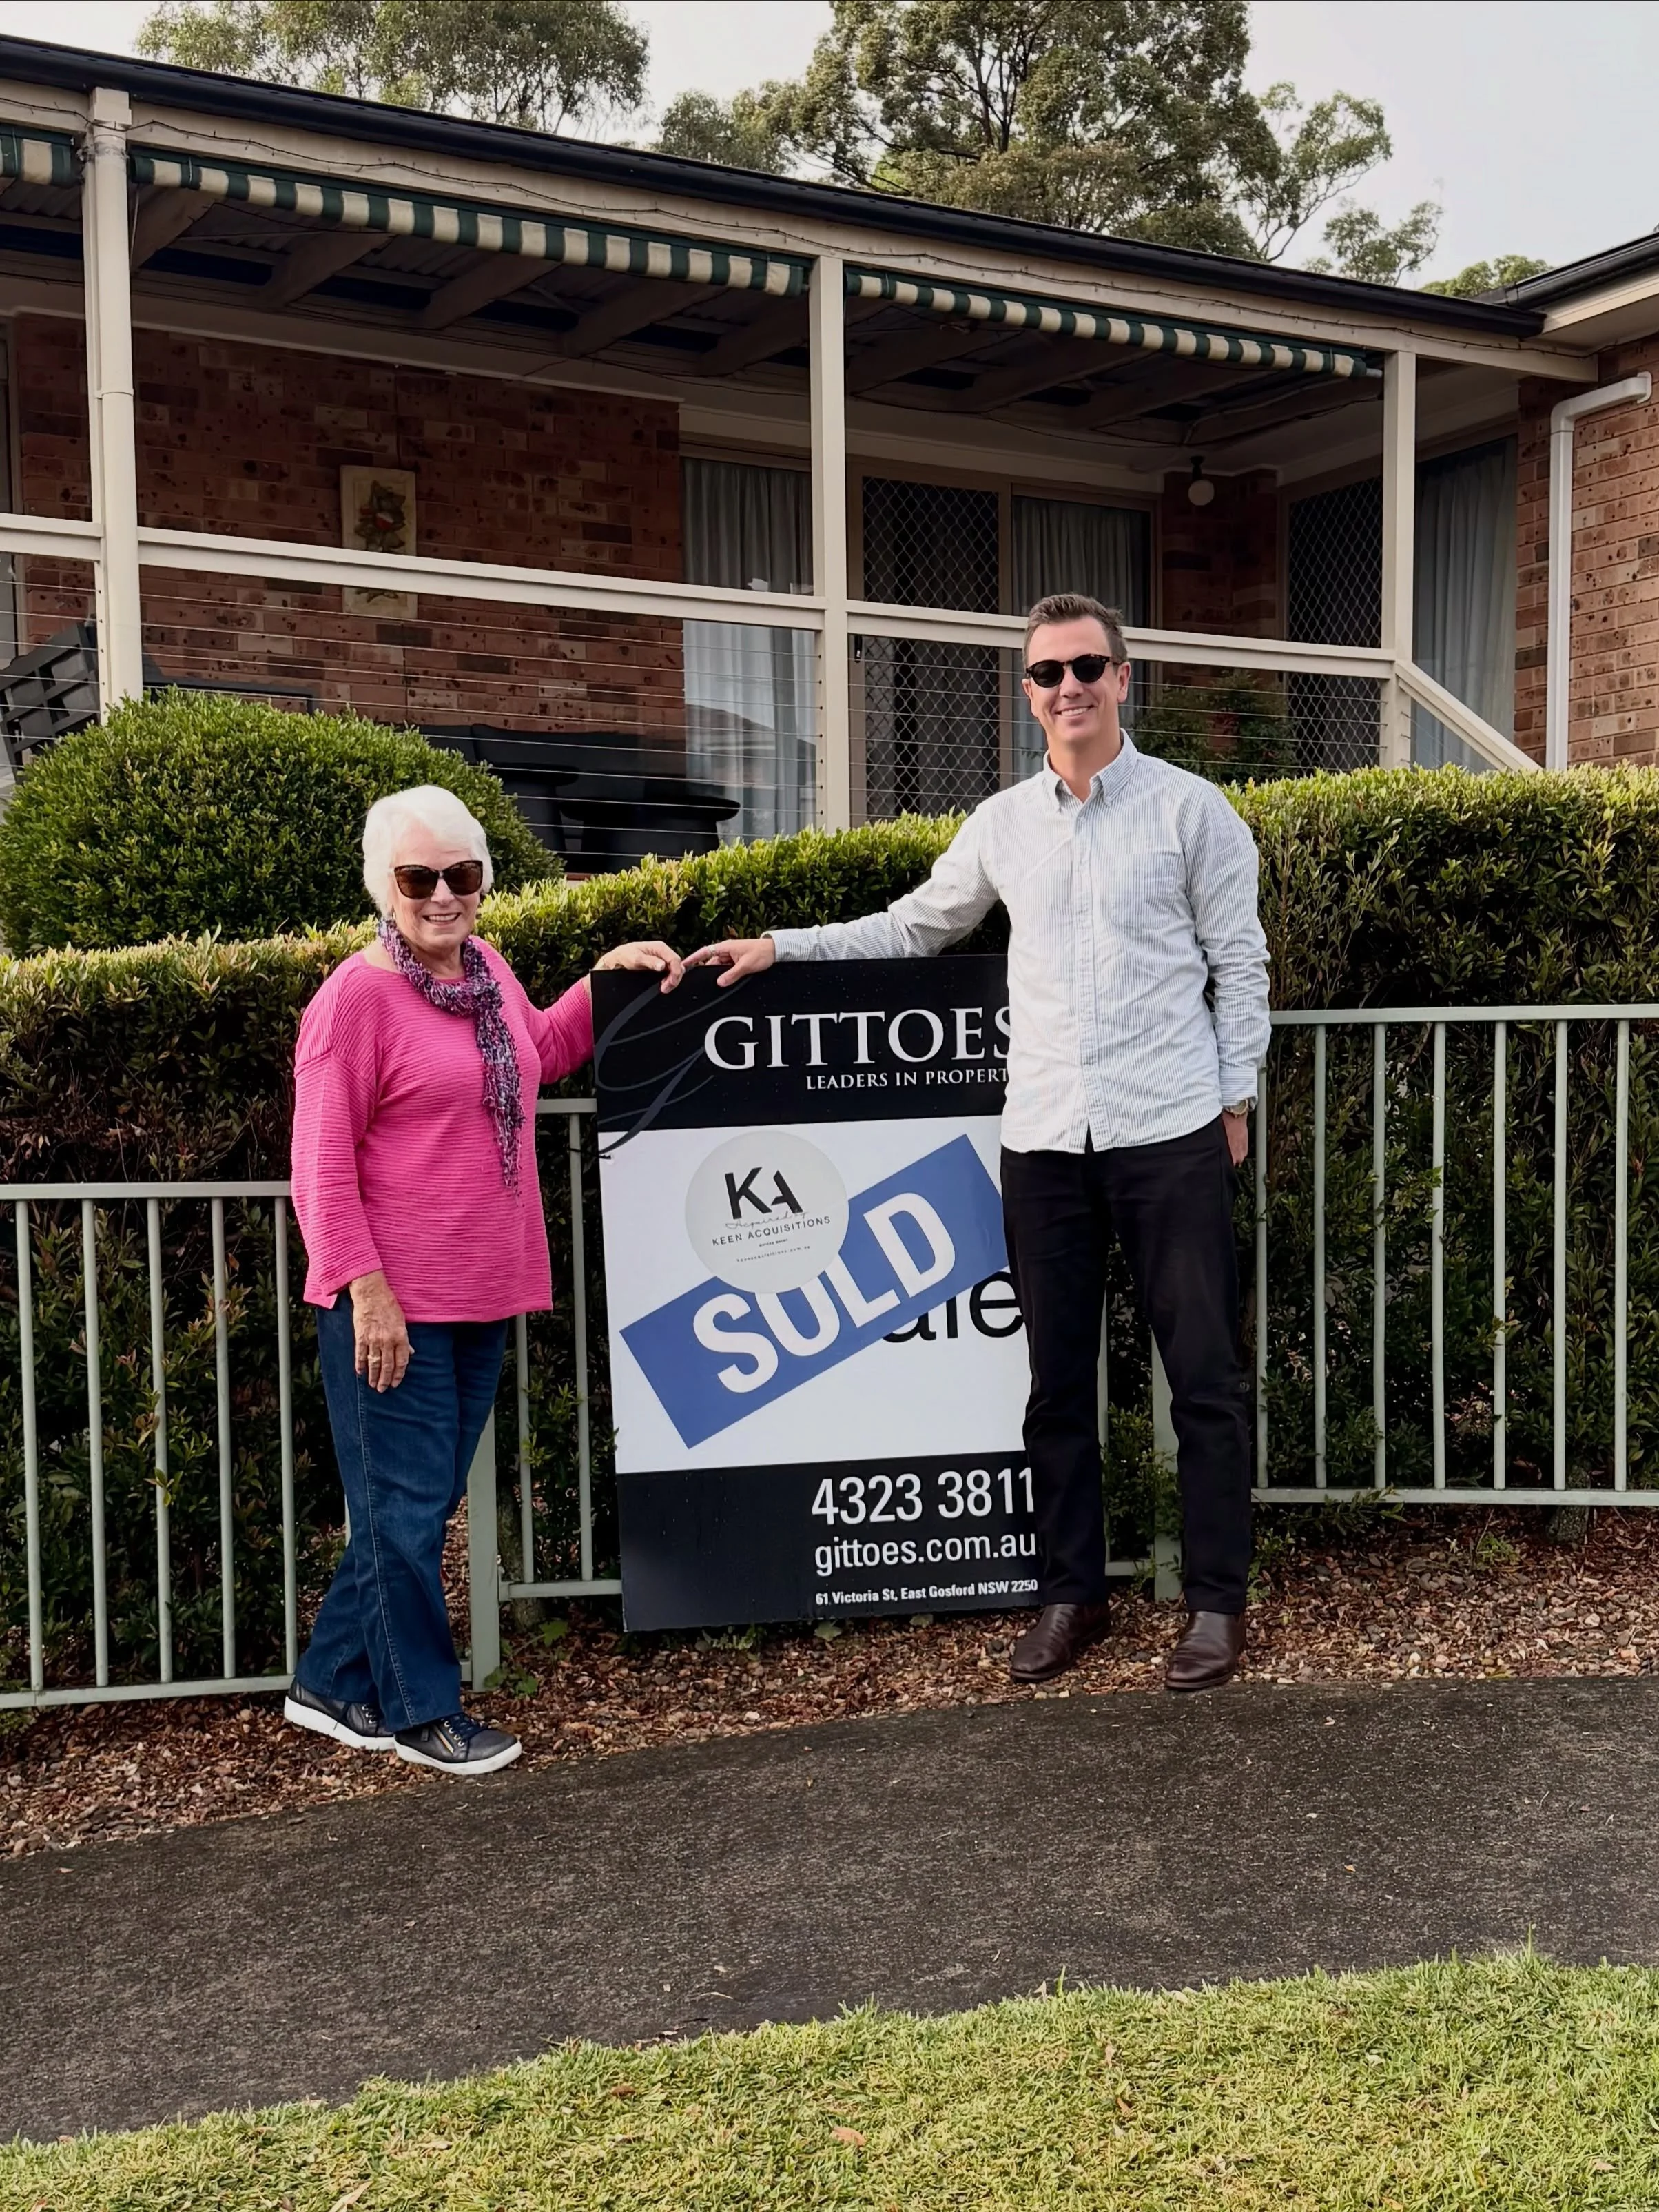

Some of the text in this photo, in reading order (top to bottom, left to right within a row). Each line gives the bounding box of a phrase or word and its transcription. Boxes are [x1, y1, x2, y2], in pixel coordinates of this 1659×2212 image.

[704, 1005, 1011, 1071] GITTOES
[806, 1067, 1009, 1090] LEADERS IN PROPERT
[724, 1167, 804, 1220] KA
[712, 1233, 743, 1246] KEEN
[748, 1216, 831, 1240] ACQUISITIONS
[692, 1192, 956, 1393] SOLD
[811, 1467, 1035, 1526] 4323 3811
[814, 1533, 1037, 1577] gittoes.com.au
[815, 1579, 1038, 1605] 61 Victoria St, East Gosford NSW 2250
